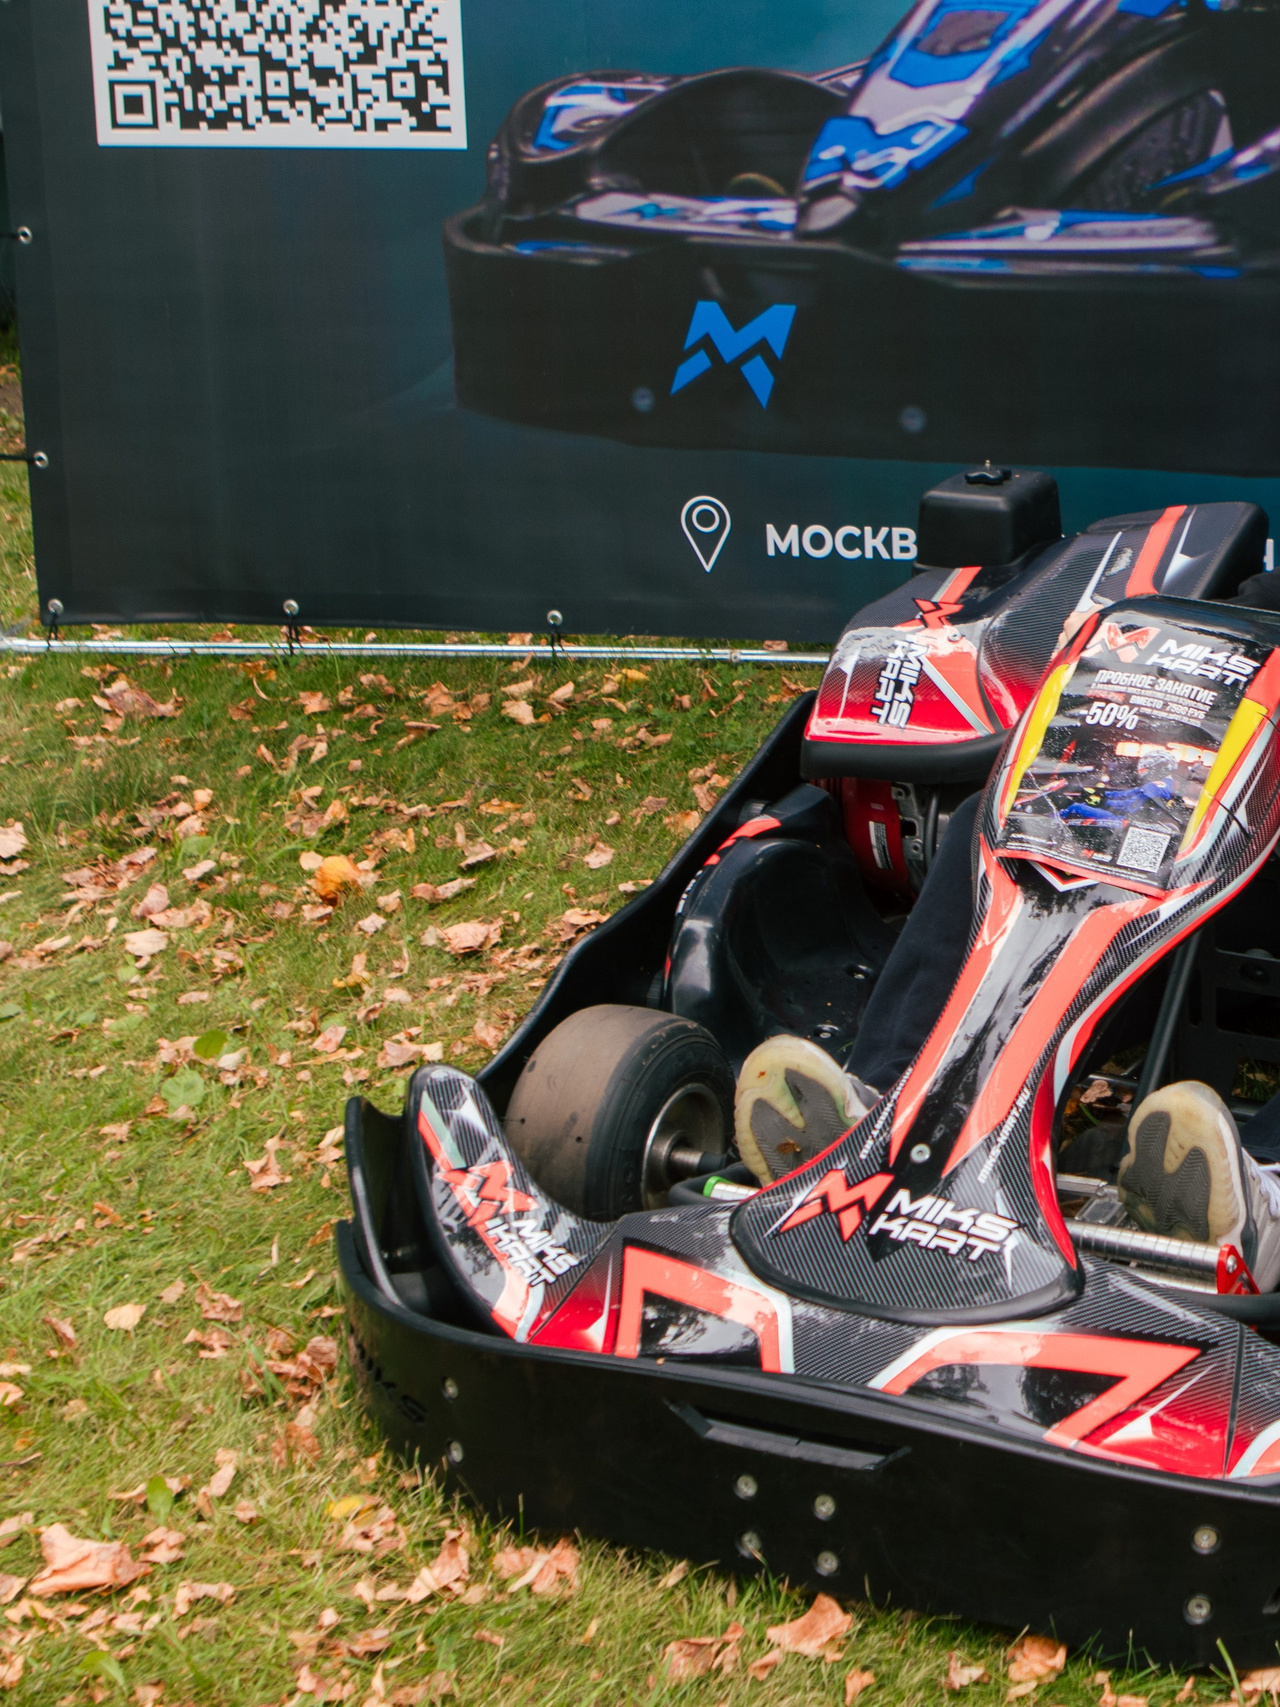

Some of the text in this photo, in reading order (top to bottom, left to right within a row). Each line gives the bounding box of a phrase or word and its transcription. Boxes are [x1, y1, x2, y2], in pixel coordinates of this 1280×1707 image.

[766, 523, 919, 561] МОСКВ
[870, 639, 910, 725] KART
[1145, 653, 1249, 687] KART
[1157, 638, 1261, 676] MIKS
[886, 641, 929, 731] MIKS
[1094, 669, 1157, 690] ПРОБНОЕ
[1154, 676, 1218, 706] ЗАНЯТИЕ
[1129, 694, 1164, 710] ВМЕСТО
[868, 1212, 1001, 1262] KART
[884, 1187, 1020, 1242] MIKS
[486, 1223, 558, 1288] KART
[511, 1218, 580, 1277] MIKS
